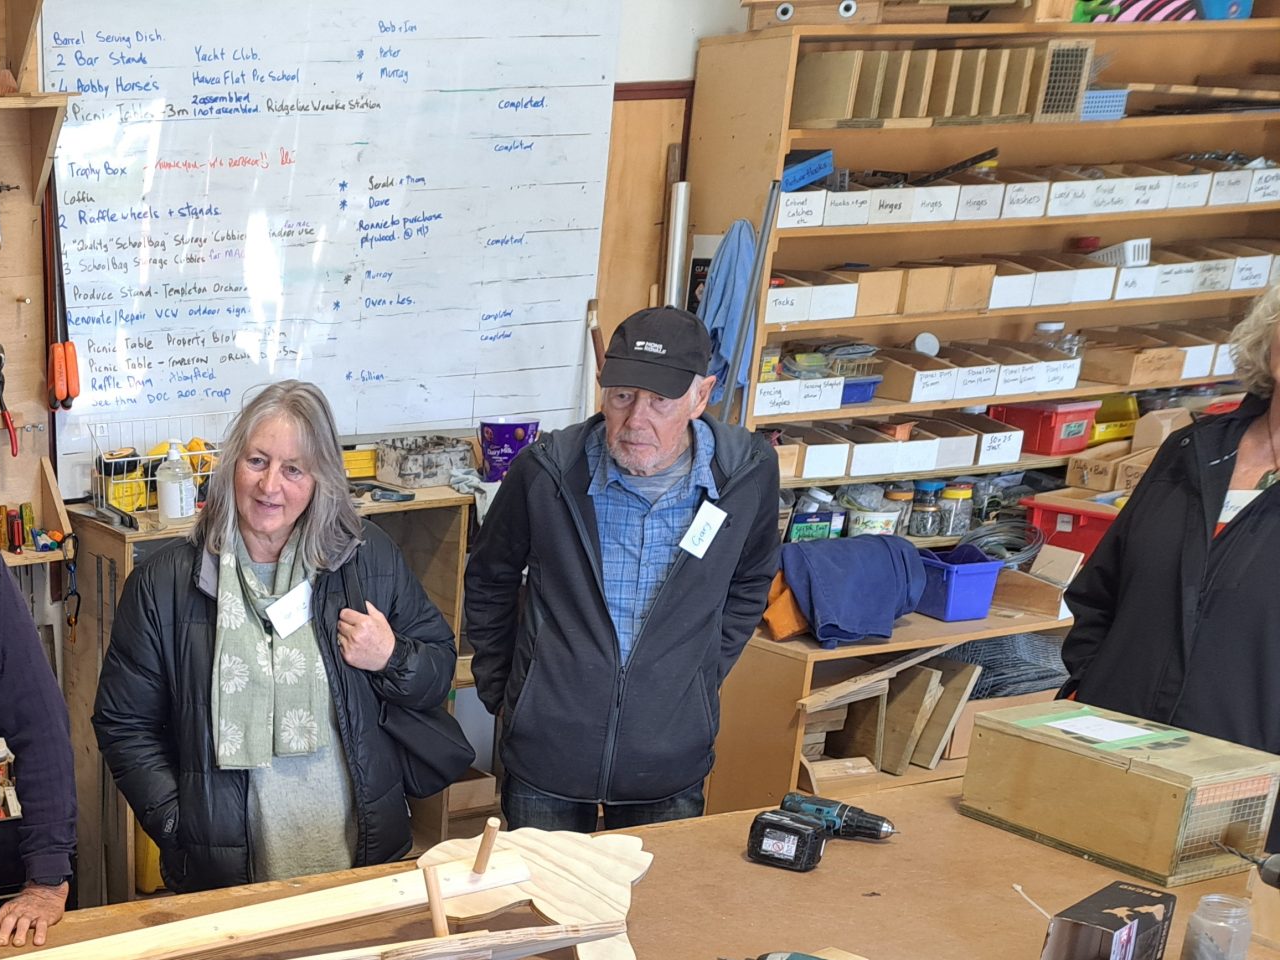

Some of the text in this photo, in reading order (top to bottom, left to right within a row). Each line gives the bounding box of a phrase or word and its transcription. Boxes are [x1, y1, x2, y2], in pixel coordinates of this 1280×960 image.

[378, 20, 396, 33] Bob
[53, 29, 166, 48] Barrel Serving Dish.
[56, 50, 148, 66] 2 Bar Stands
[194, 45, 225, 62] Yacht
[379, 47, 401, 58] Peter
[192, 68, 300, 86] Hawea Flat Pre School
[380, 67, 409, 83] Murray
[58, 78, 68, 92] 4
[69, 160, 127, 181] Trophy Box
[369, 195, 390, 209] Dave
[878, 200, 903, 211] Hinges
[920, 199, 943, 209] Hinges
[966, 199, 988, 210] Hinges
[58, 215, 68, 229] 2
[78, 208, 118, 225] Raffle
[121, 205, 160, 222] wheels
[358, 210, 443, 232] Ronnie to purchase
[64, 262, 71, 275] 3
[365, 270, 393, 281] Murray
[73, 286, 114, 301] Produce
[120, 285, 152, 299] Stand
[163, 283, 208, 299] Templeton
[364, 297, 386, 308] Owen
[773, 298, 795, 307] Tacks
[188, 307, 220, 318] outdoor
[87, 333, 206, 354] Picnic Table Property
[89, 357, 118, 373] Picnic
[125, 359, 152, 371] Table
[91, 378, 123, 392] Raffle
[177, 389, 196, 399] 200
[203, 388, 232, 404] Trap
[759, 387, 782, 398] Fencing
[769, 400, 790, 408] Staples
[692, 521, 712, 546] Gary
